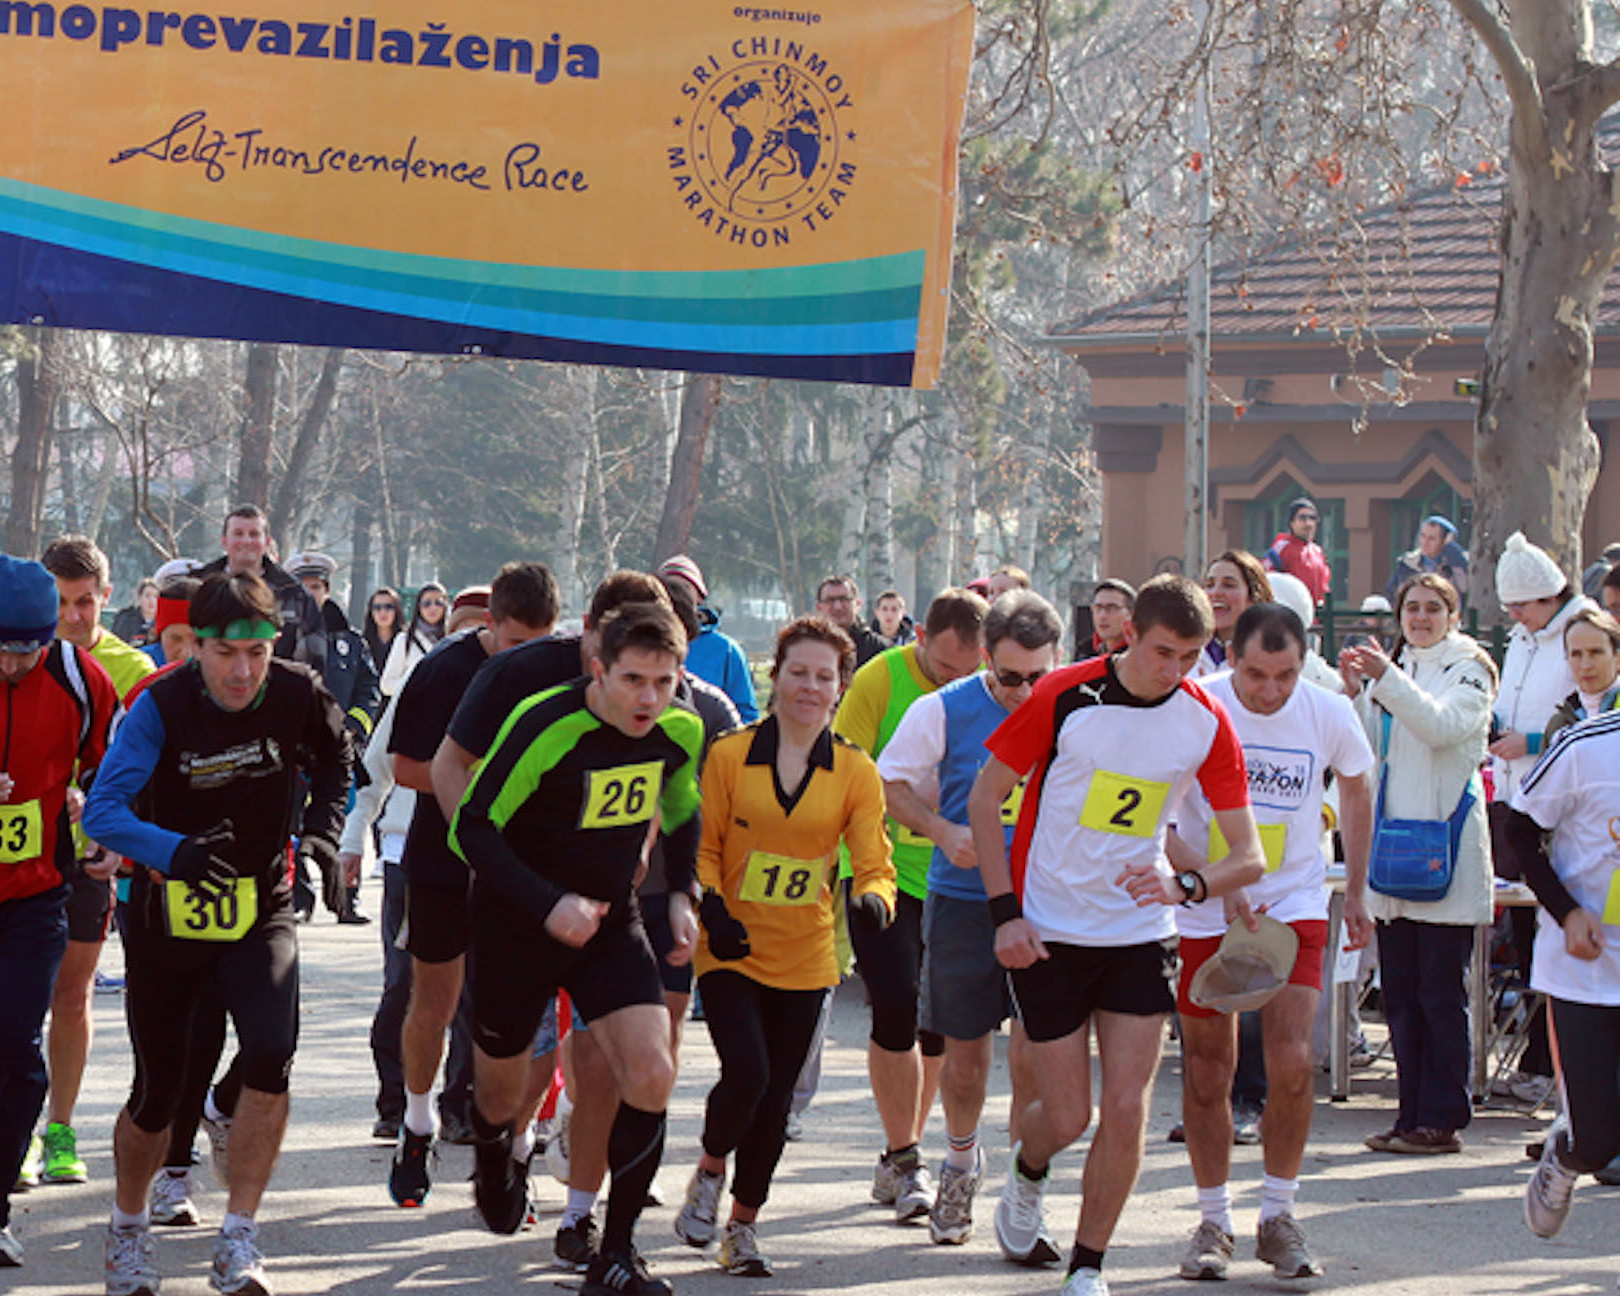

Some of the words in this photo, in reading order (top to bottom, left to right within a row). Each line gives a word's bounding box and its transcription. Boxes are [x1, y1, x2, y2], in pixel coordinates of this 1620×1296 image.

[682, 55, 721, 100] SRI
[732, 36, 853, 110] CHINMOY
[109, 110, 490, 189] Self-Transcendence
[505, 143, 589, 192] Race
[667, 147, 790, 247] MARATHON
[802, 162, 857, 231] TEAM
[598, 776, 647, 818] 26
[1110, 787, 1141, 827] 2
[762, 865, 810, 899] 18
[184, 891, 238, 930] 30
